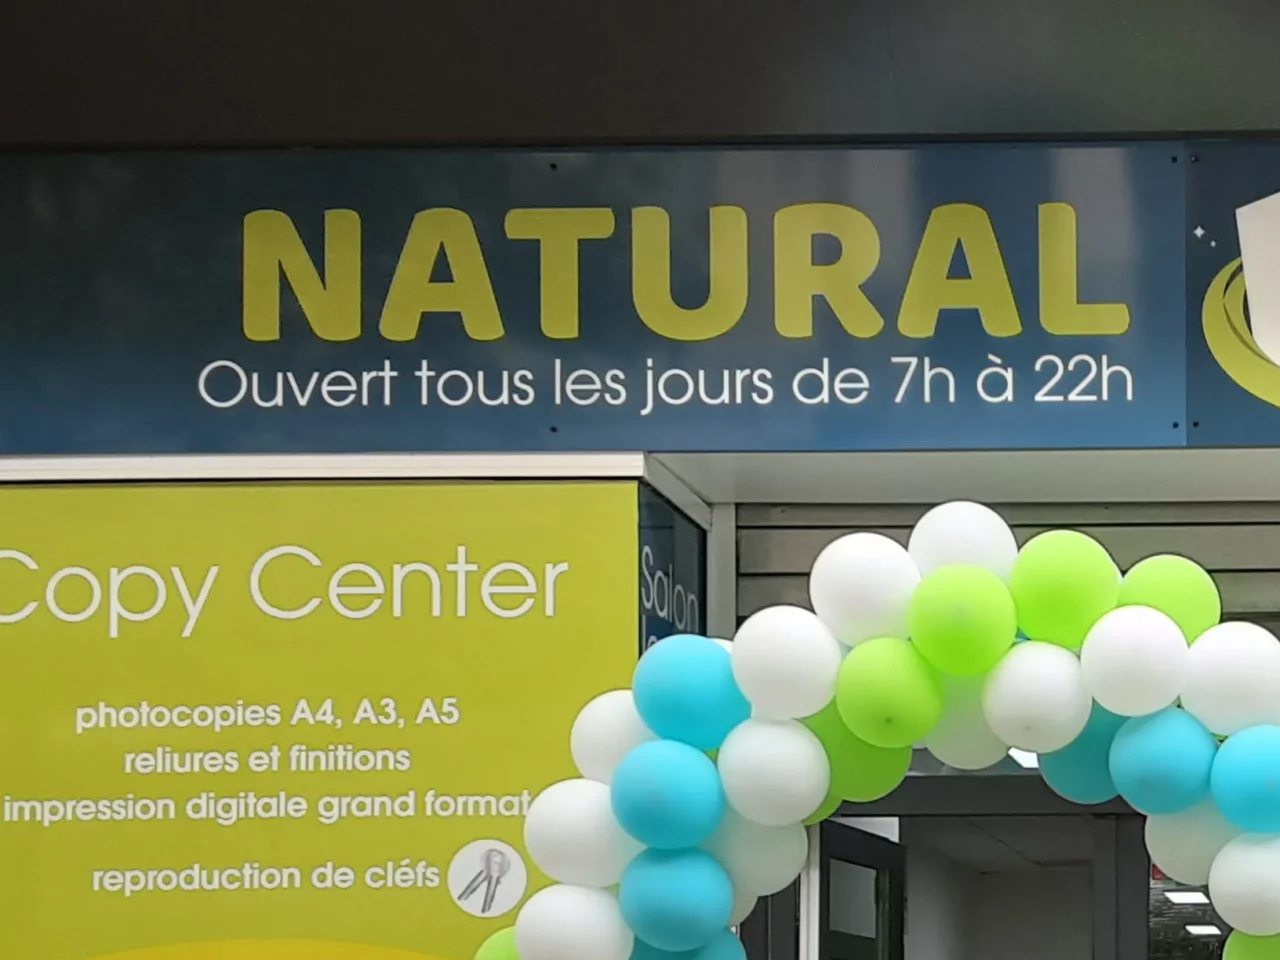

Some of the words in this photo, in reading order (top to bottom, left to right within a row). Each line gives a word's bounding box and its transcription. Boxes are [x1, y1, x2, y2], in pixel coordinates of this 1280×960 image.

[243, 202, 1131, 342] NATURAL
[199, 359, 398, 408] Ouvert
[414, 359, 535, 406] tous
[554, 358, 627, 406] les
[640, 358, 774, 416] jours
[792, 357, 870, 405] de
[890, 356, 956, 404] 7h
[976, 354, 1014, 404] à
[1034, 354, 1133, 402] 22h
[0, 549, 220, 639] Copy
[249, 545, 570, 620] Center
[641, 545, 699, 634] Salon
[75, 699, 282, 735] photocopies
[289, 698, 343, 729] A4,
[352, 697, 406, 728] A3,
[415, 697, 461, 726] A5
[124, 746, 240, 775] reliures
[247, 744, 282, 773] et
[289, 744, 412, 772] finitions
[3, 794, 176, 828] impression
[184, 790, 309, 826] digitale
[317, 789, 417, 825] grand
[424, 788, 532, 817] format
[92, 862, 302, 897] reproduction
[310, 861, 357, 890] de
[364, 857, 441, 889] cléfs
